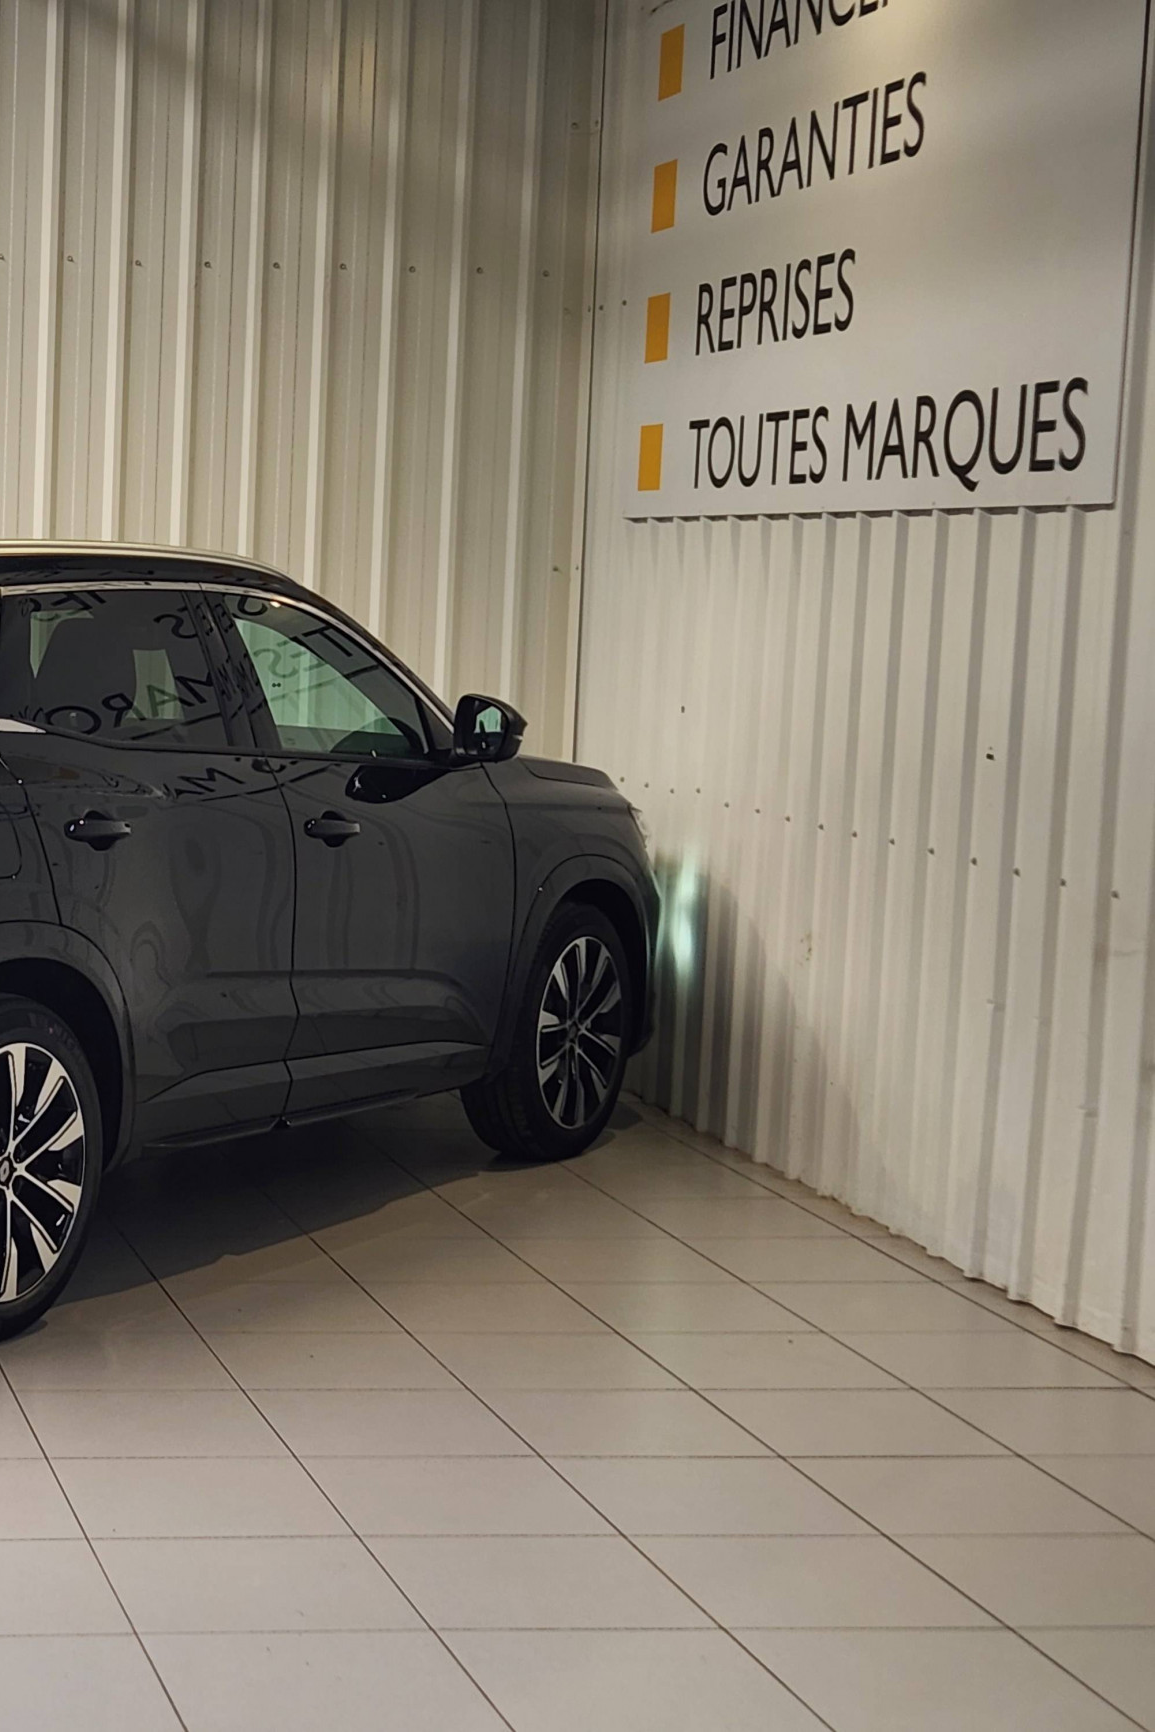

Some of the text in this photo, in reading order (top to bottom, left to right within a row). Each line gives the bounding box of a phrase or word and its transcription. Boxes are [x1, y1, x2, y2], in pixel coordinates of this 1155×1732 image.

[710, 0, 888, 80] FINAN
[703, 71, 927, 216] GARANTIES
[695, 248, 856, 356] REPRISES
[689, 376, 1089, 492] TOUTES MARQUES
